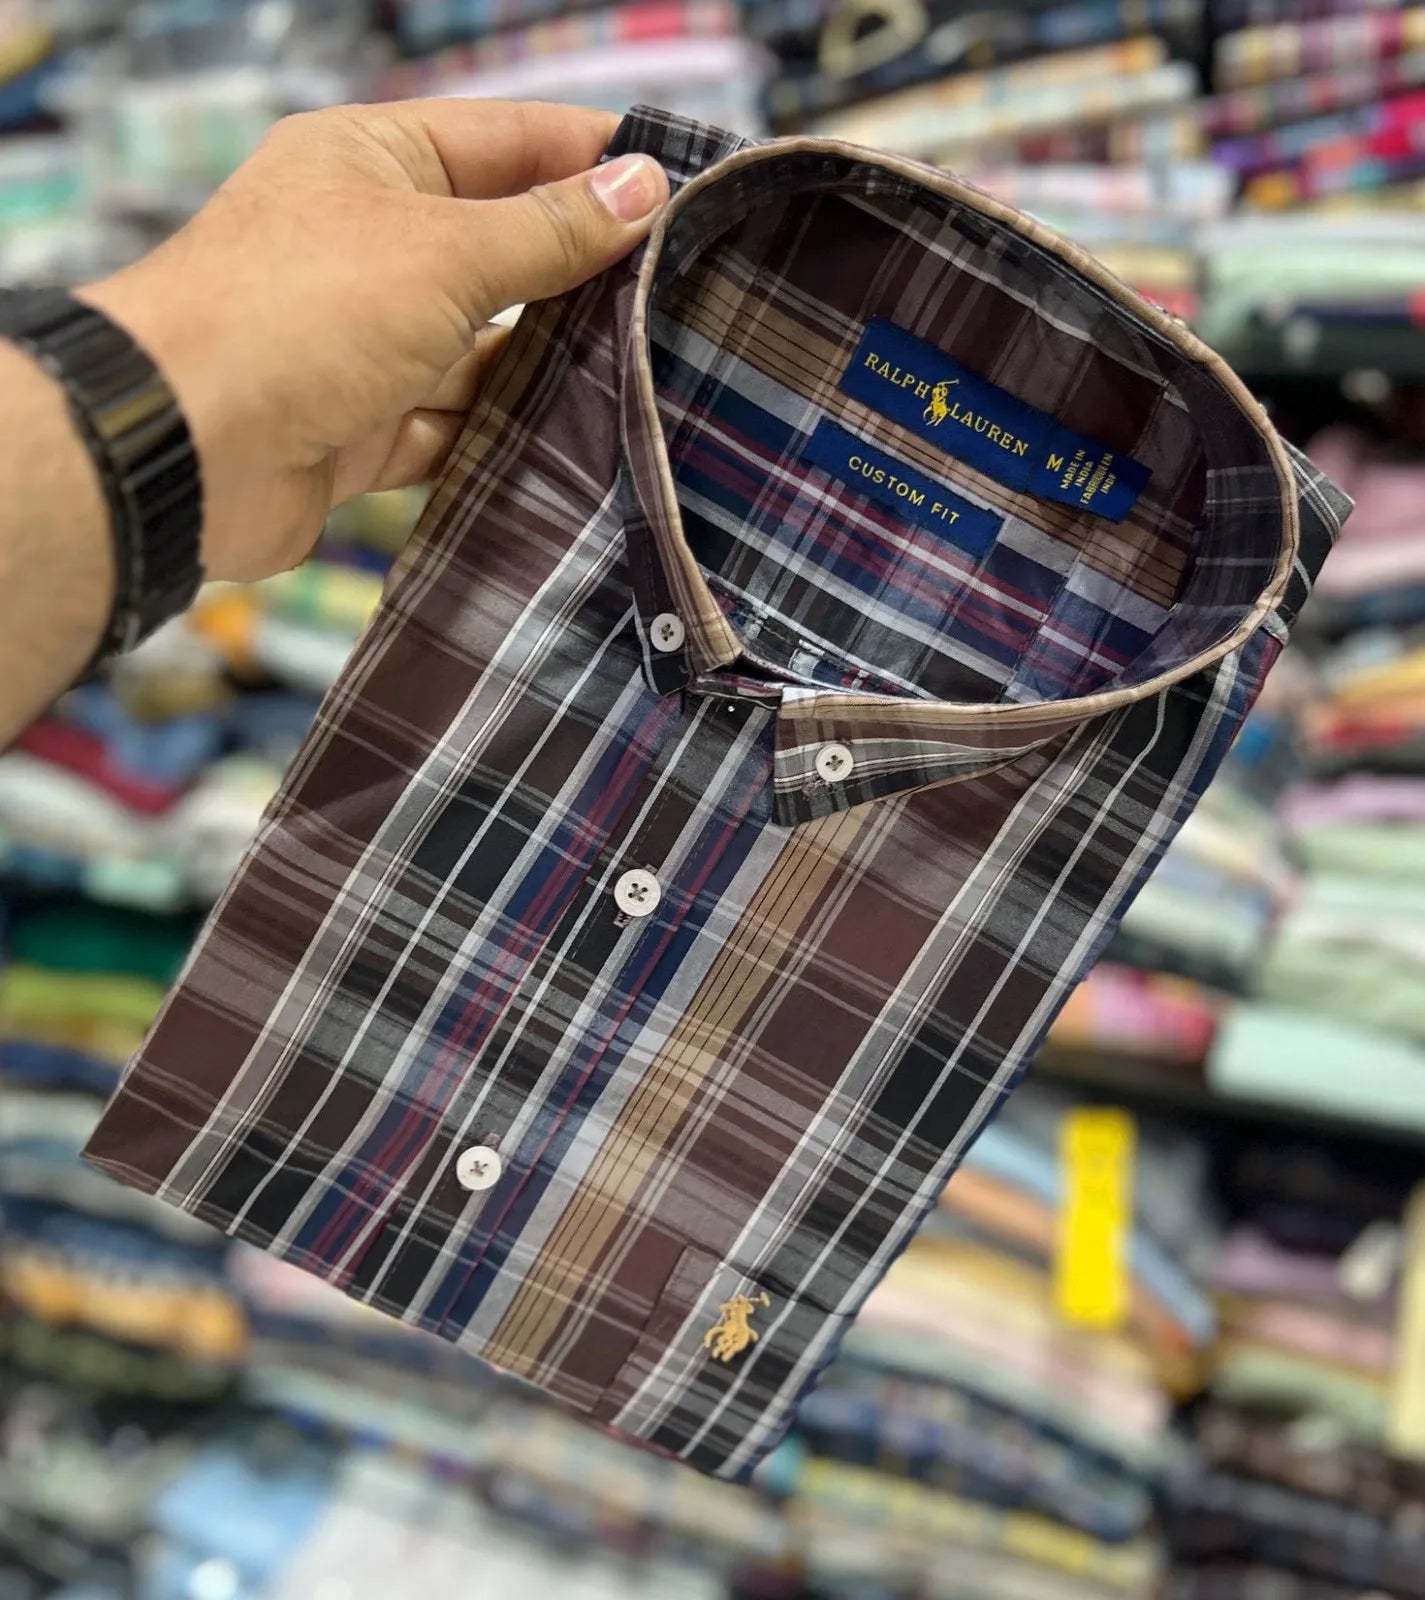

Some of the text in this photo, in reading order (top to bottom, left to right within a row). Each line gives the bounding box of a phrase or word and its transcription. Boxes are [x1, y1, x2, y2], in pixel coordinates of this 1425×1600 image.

[864, 352, 1029, 456] RALPH LAUREN
[1046, 453, 1064, 472] M
[1060, 449, 1086, 489] MADE IN
[1074, 461, 1094, 487] INDIA
[848, 456, 960, 525] CUSTOM FIT
